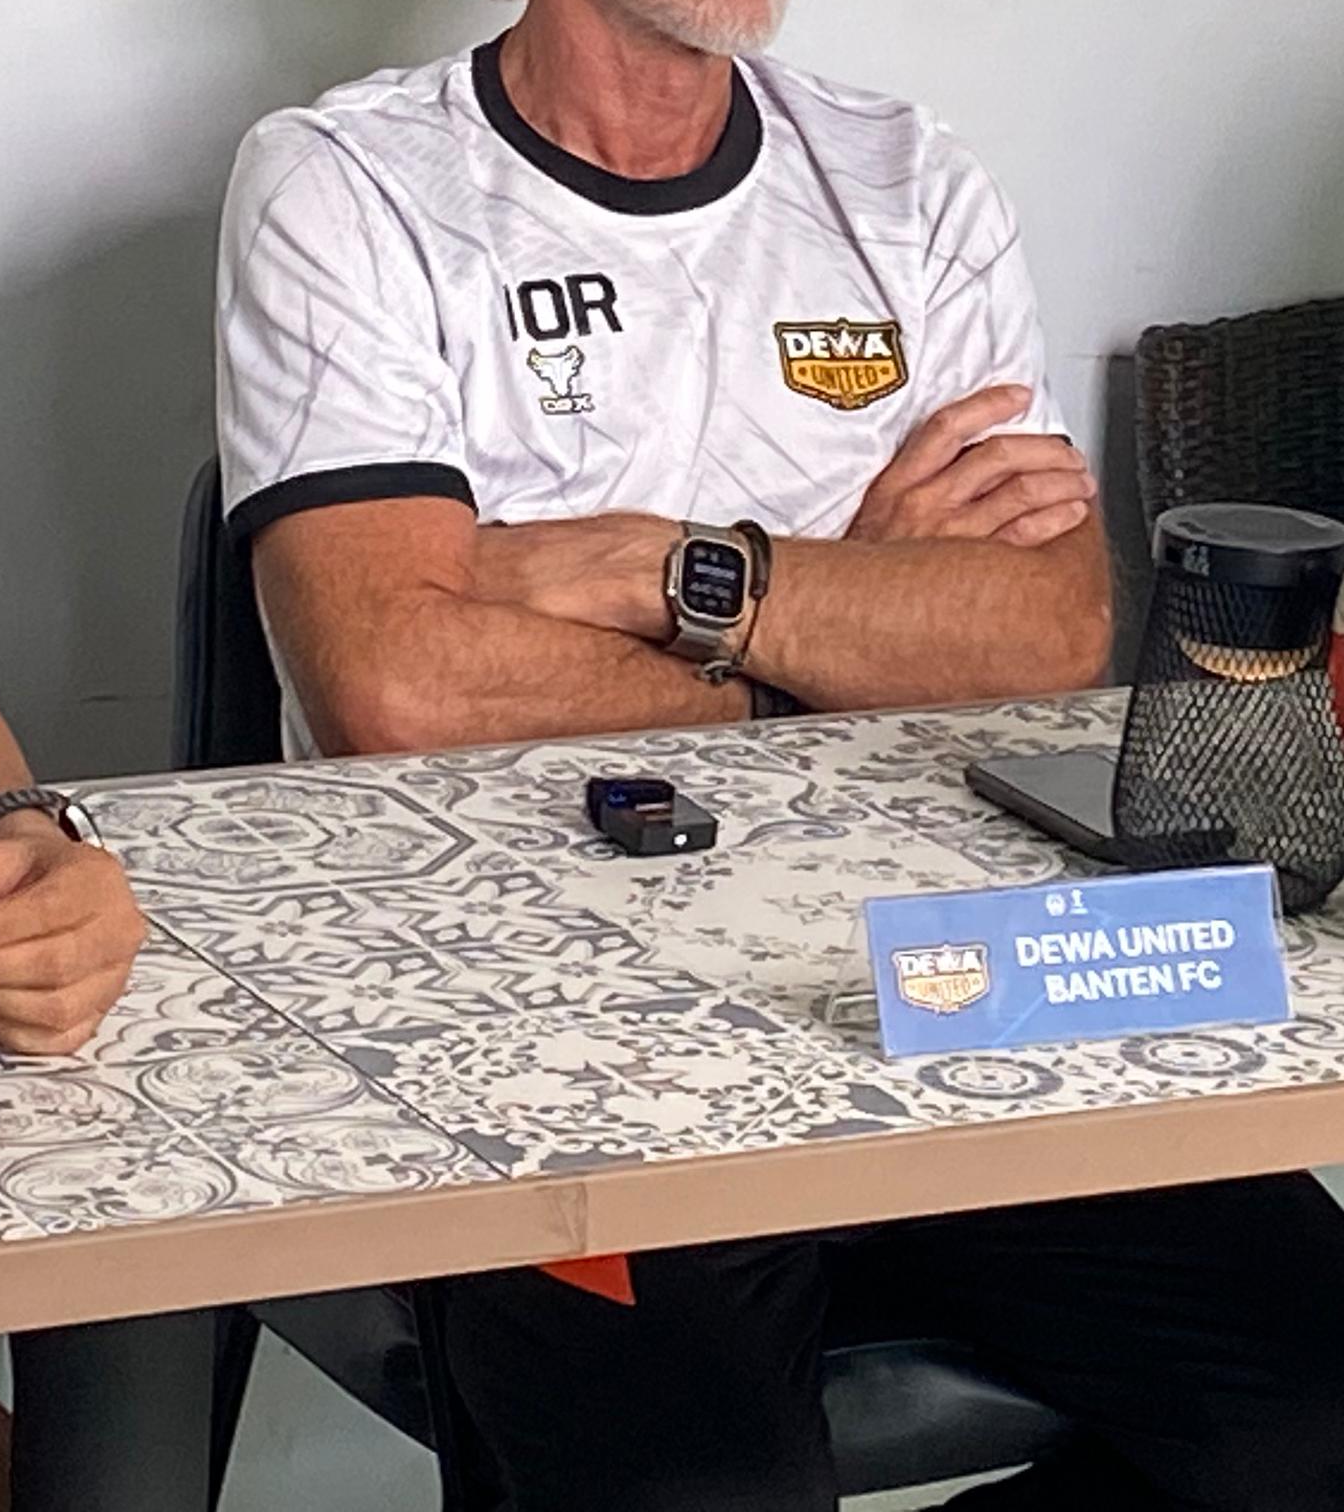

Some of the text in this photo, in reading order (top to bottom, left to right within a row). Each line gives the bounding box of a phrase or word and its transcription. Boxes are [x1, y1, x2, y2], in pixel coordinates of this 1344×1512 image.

[781, 329, 893, 359] DEWA
[810, 364, 880, 393] UNITED
[1014, 919, 1236, 967] DEWA UNITED
[897, 951, 983, 977] DEWA
[1043, 959, 1223, 1005] BANTEN FC
